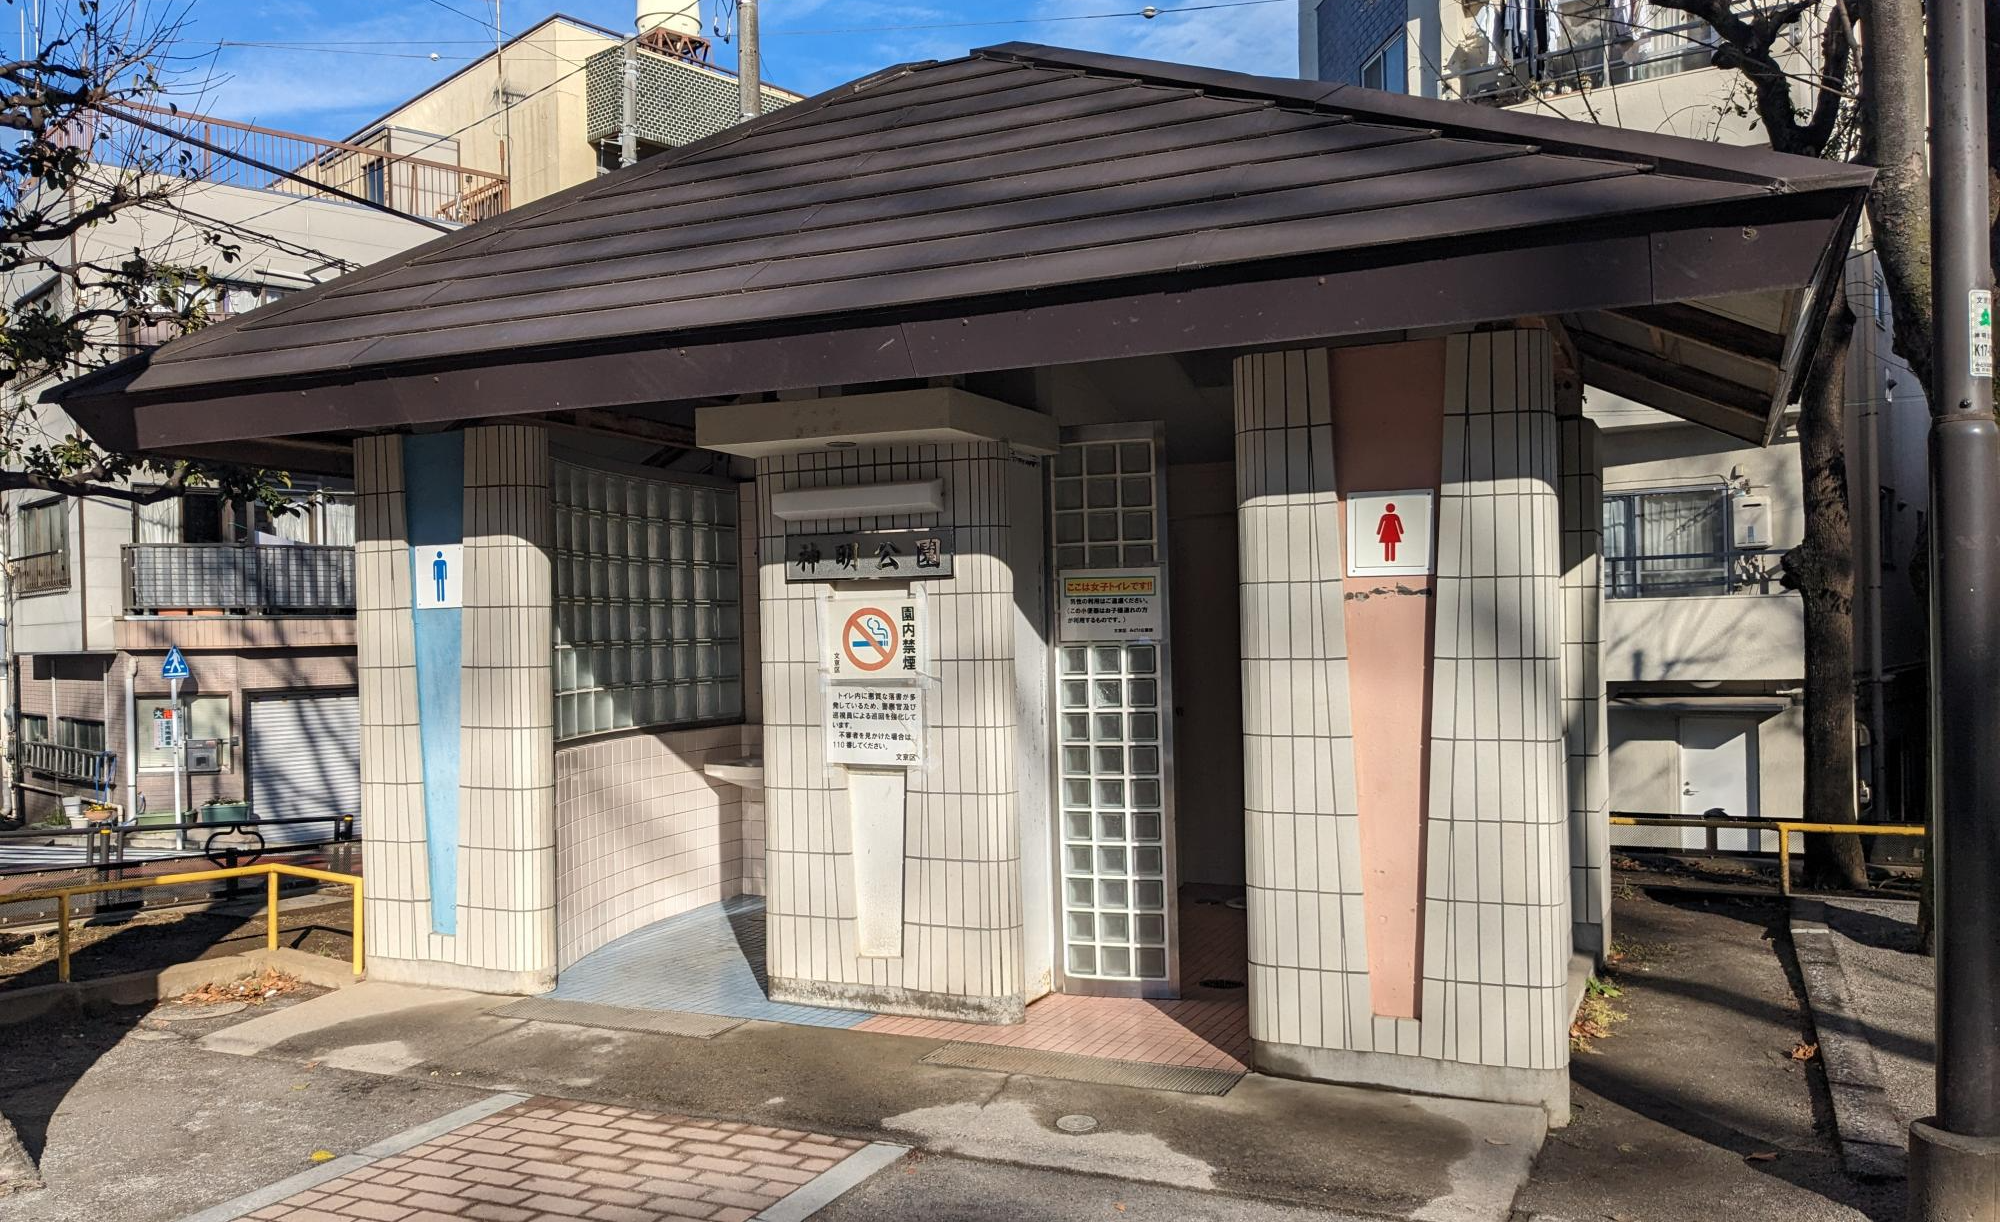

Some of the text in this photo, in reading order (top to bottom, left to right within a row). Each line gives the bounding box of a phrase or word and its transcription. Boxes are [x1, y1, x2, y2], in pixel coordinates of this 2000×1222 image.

[796, 538, 942, 574] 神明公園
[901, 606, 917, 671] 園内禁煙
[833, 652, 841, 674] 文京区
[838, 692, 916, 701] トイレ内に悪質な落書が多
[832, 702, 917, 711] 発しているため、警察官及び
[832, 712, 917, 721] 巡視員による巡回を強化して
[832, 722, 853, 730] います。
[895, 753, 916, 762] 文京区
